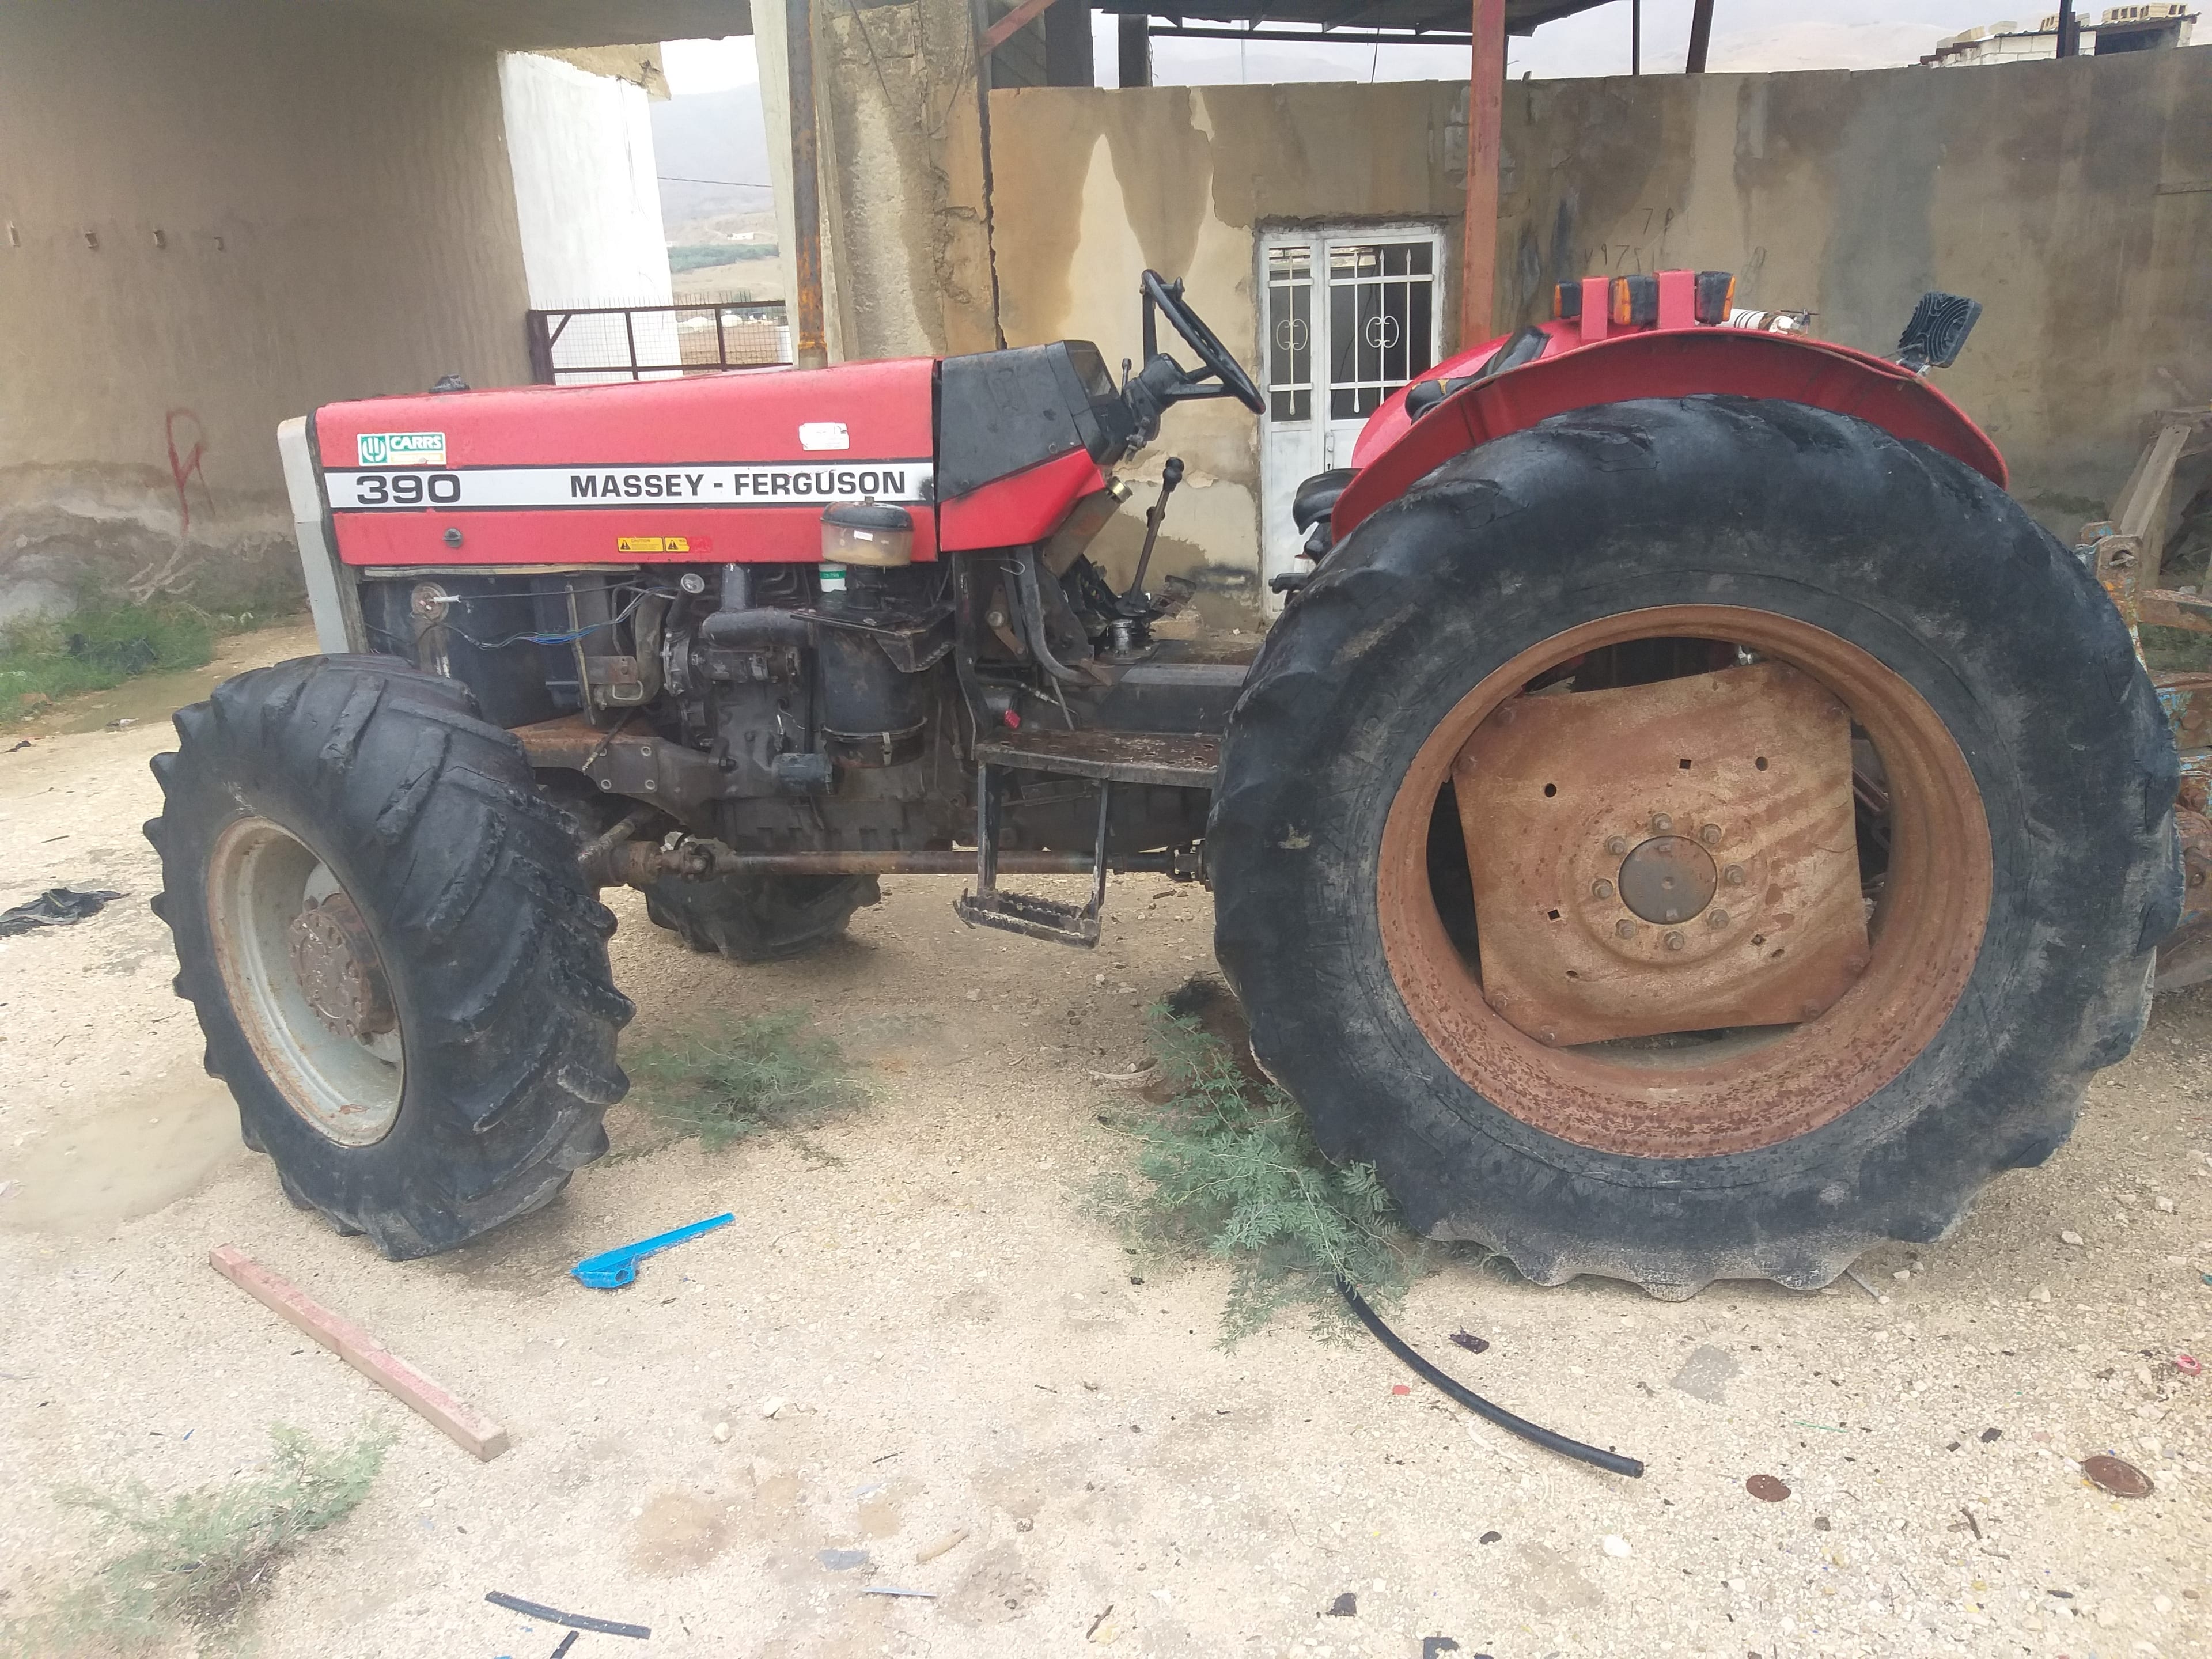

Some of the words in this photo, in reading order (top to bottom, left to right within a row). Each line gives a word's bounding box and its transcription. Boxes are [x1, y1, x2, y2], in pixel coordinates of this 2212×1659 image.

[390, 435, 442, 450] CARRS
[356, 474, 461, 505] 390
[570, 474, 704, 498] MASSEY
[734, 471, 906, 496] FERGUSON
